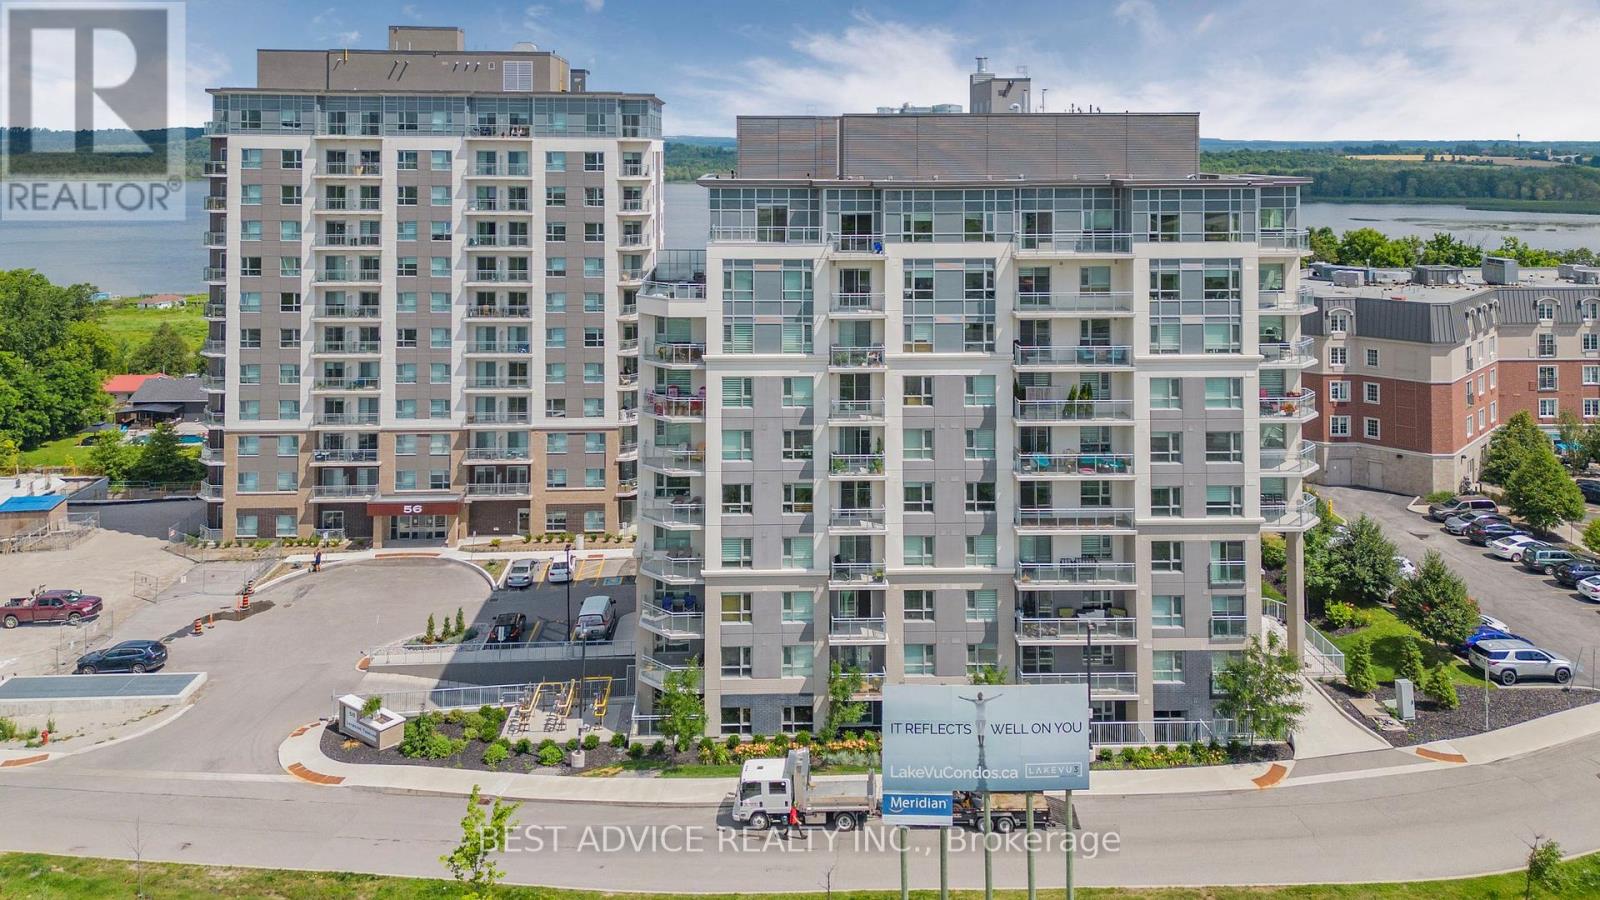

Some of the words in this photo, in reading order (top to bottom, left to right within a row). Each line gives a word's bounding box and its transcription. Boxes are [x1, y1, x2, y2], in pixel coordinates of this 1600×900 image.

[403, 505, 422, 513] 56
[890, 723, 902, 734] IT
[905, 723, 972, 735] REFLECTS
[990, 723, 1029, 735] WELL
[1031, 722, 1051, 734] ON
[1055, 721, 1082, 733] YOU
[890, 765, 1019, 779] LakeVuCondos.ca
[890, 797, 947, 810] Meridian
